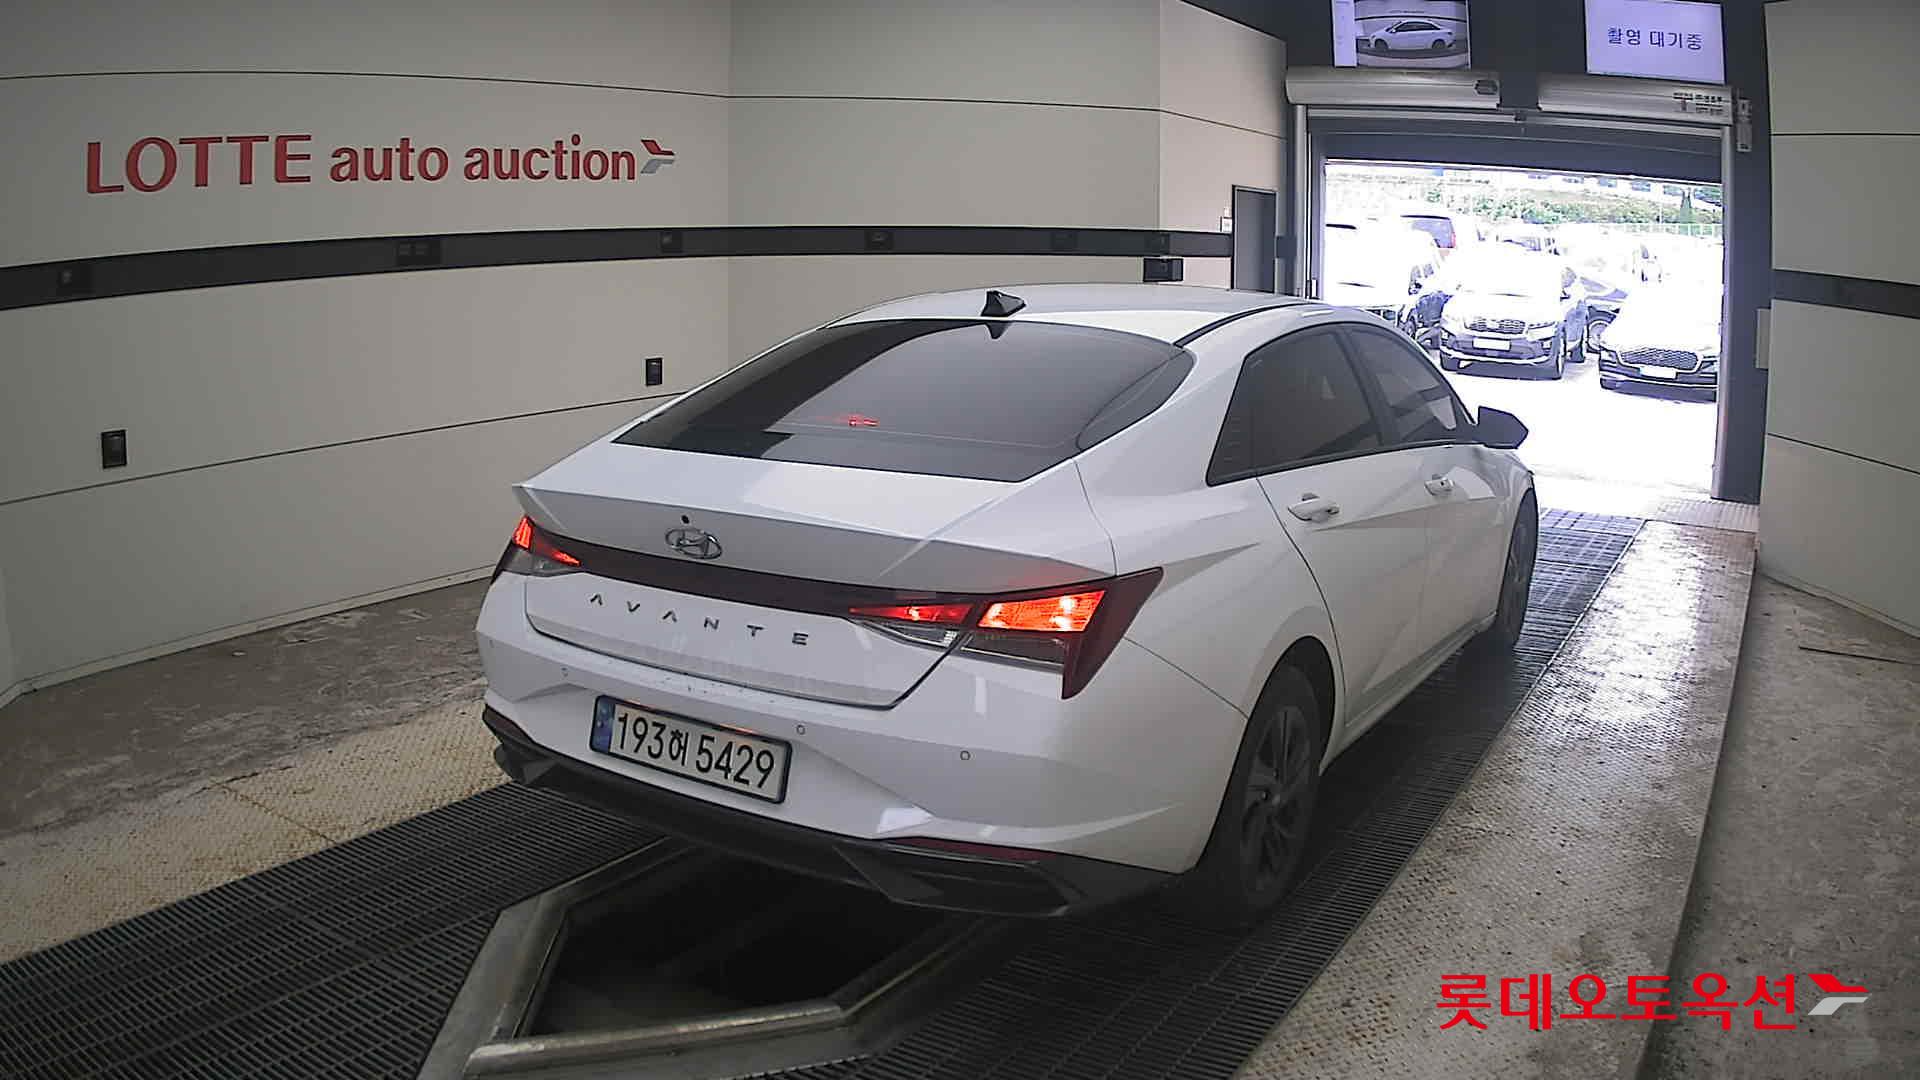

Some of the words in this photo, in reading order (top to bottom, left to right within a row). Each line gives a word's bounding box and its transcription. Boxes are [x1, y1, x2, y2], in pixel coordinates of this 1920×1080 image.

[1649, 31, 1702, 50] 대기중
[86, 134, 312, 193] LOTTE
[329, 138, 449, 181] auto
[463, 134, 636, 181] auction
[589, 593, 809, 647] AVANTE
[617, 712, 690, 767] 193허
[695, 734, 775, 789] 5429
